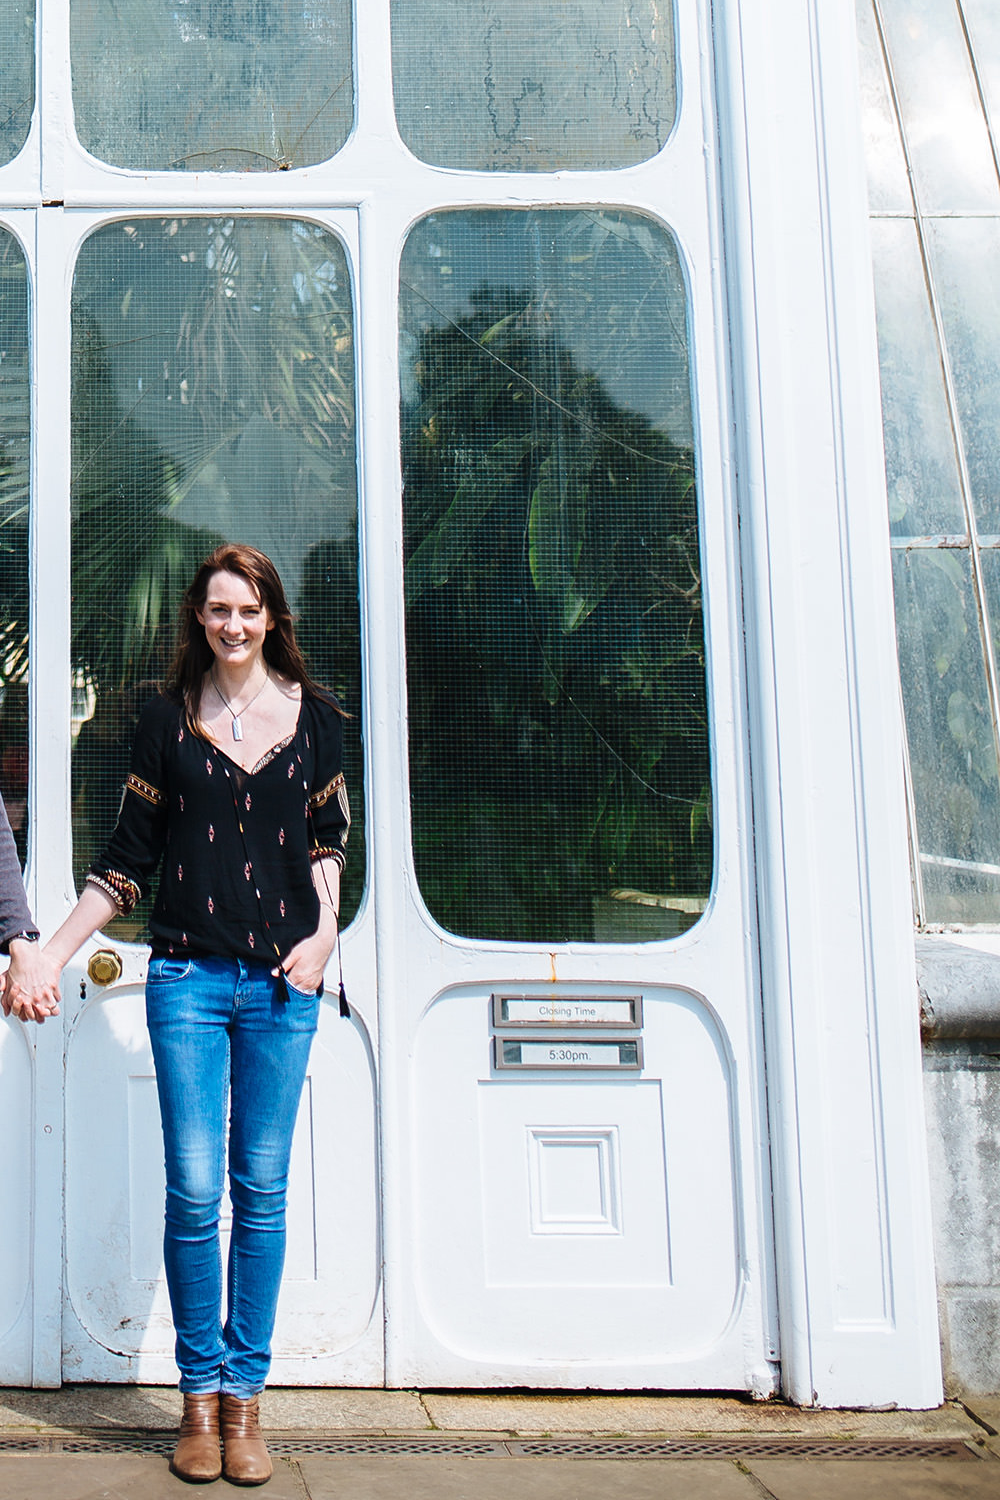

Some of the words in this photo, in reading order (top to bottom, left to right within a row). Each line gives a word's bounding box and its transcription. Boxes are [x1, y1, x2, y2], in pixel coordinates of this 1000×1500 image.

[539, 1006, 572, 1017] Closing
[575, 1007, 596, 1016] Time
[549, 1050, 592, 1062] 5:30pm.
